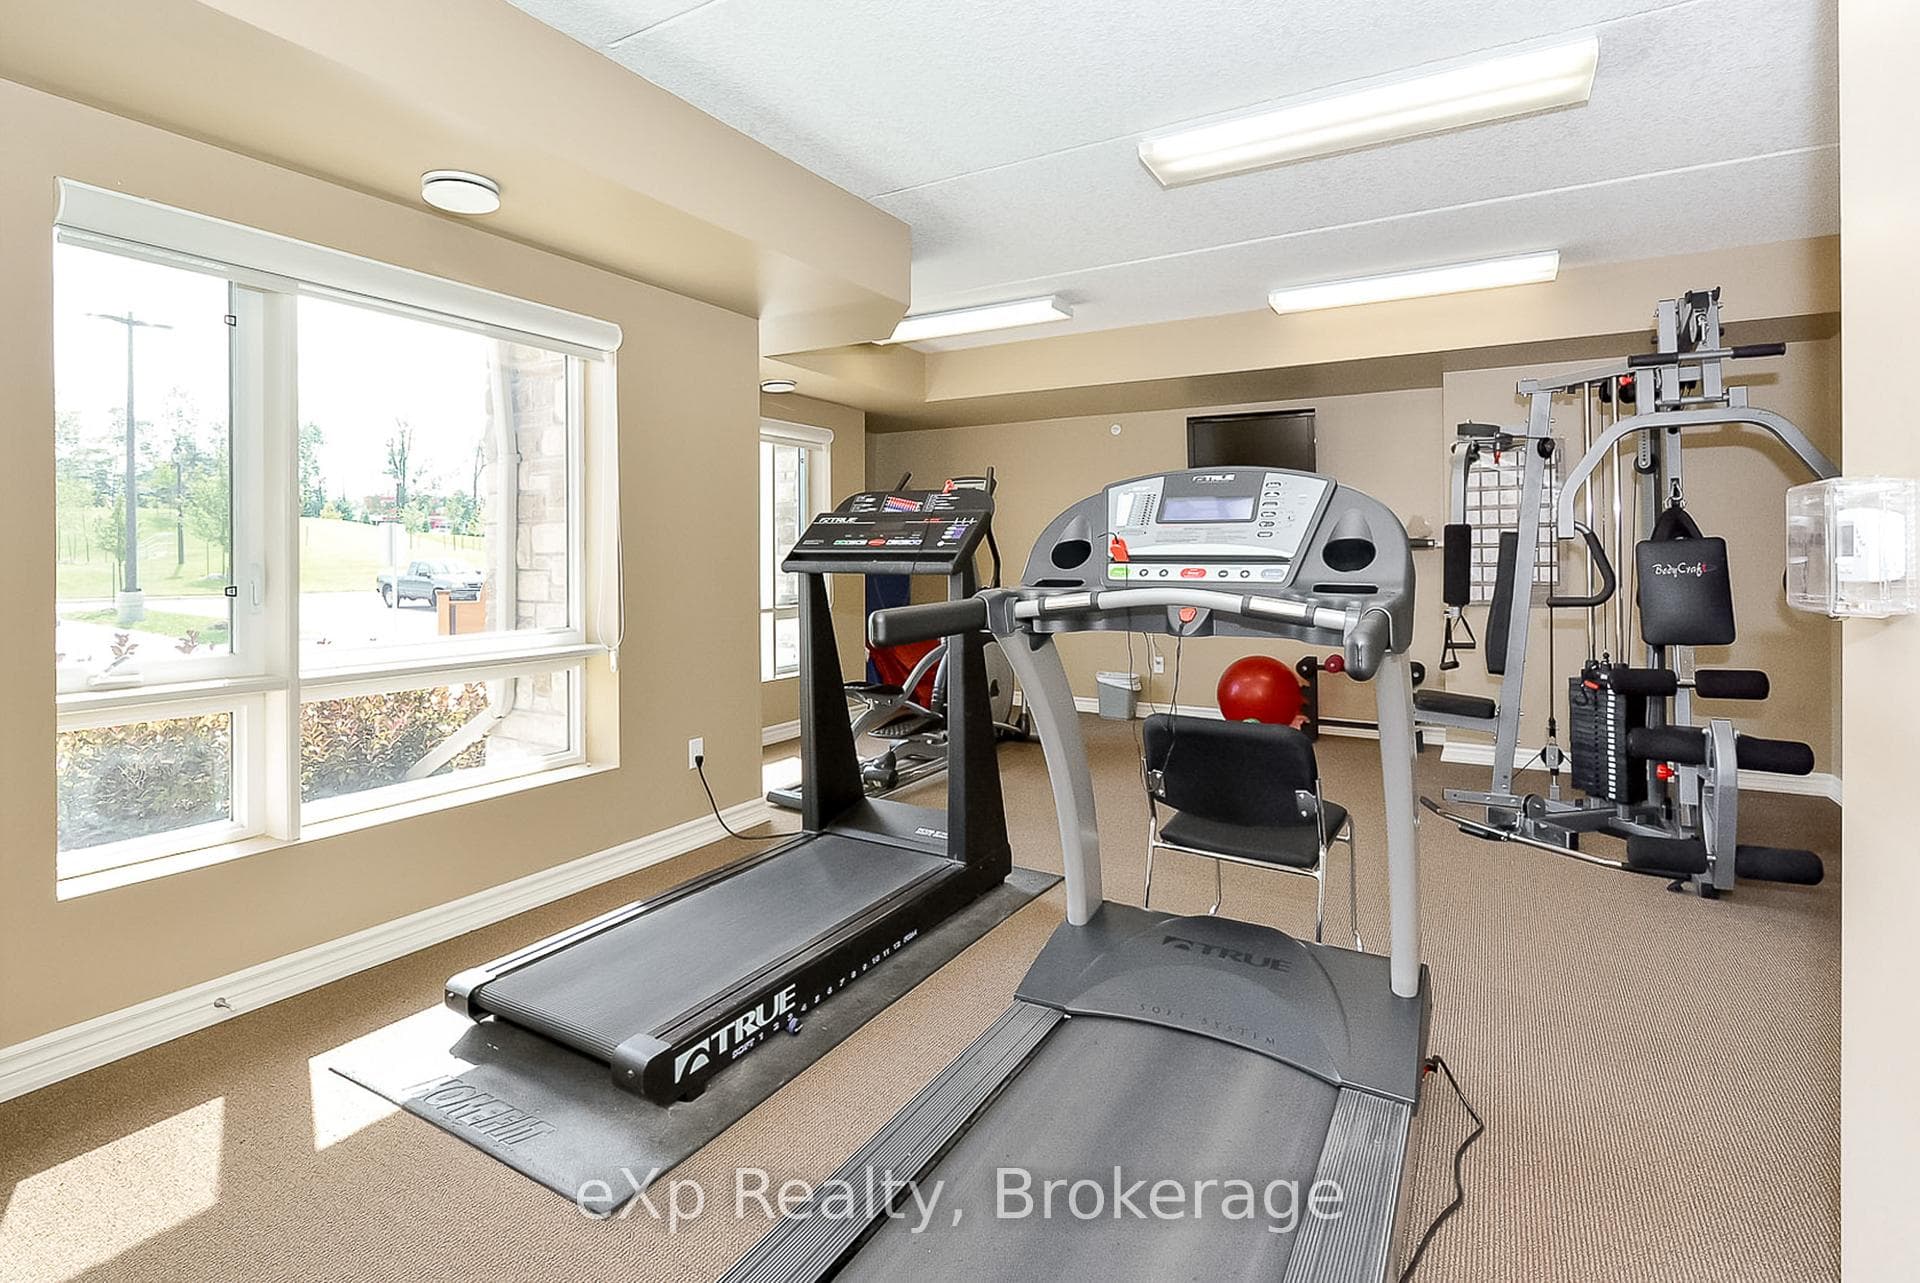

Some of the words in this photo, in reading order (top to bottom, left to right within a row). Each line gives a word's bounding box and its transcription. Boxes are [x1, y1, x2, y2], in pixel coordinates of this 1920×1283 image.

[1652, 562, 1708, 578] BodyCraft
[839, 977, 846, 987] 7
[871, 954, 880, 964] 10
[882, 947, 890, 957] 11
[1195, 943, 1293, 973] TRUE
[710, 983, 796, 1055] TRUE
